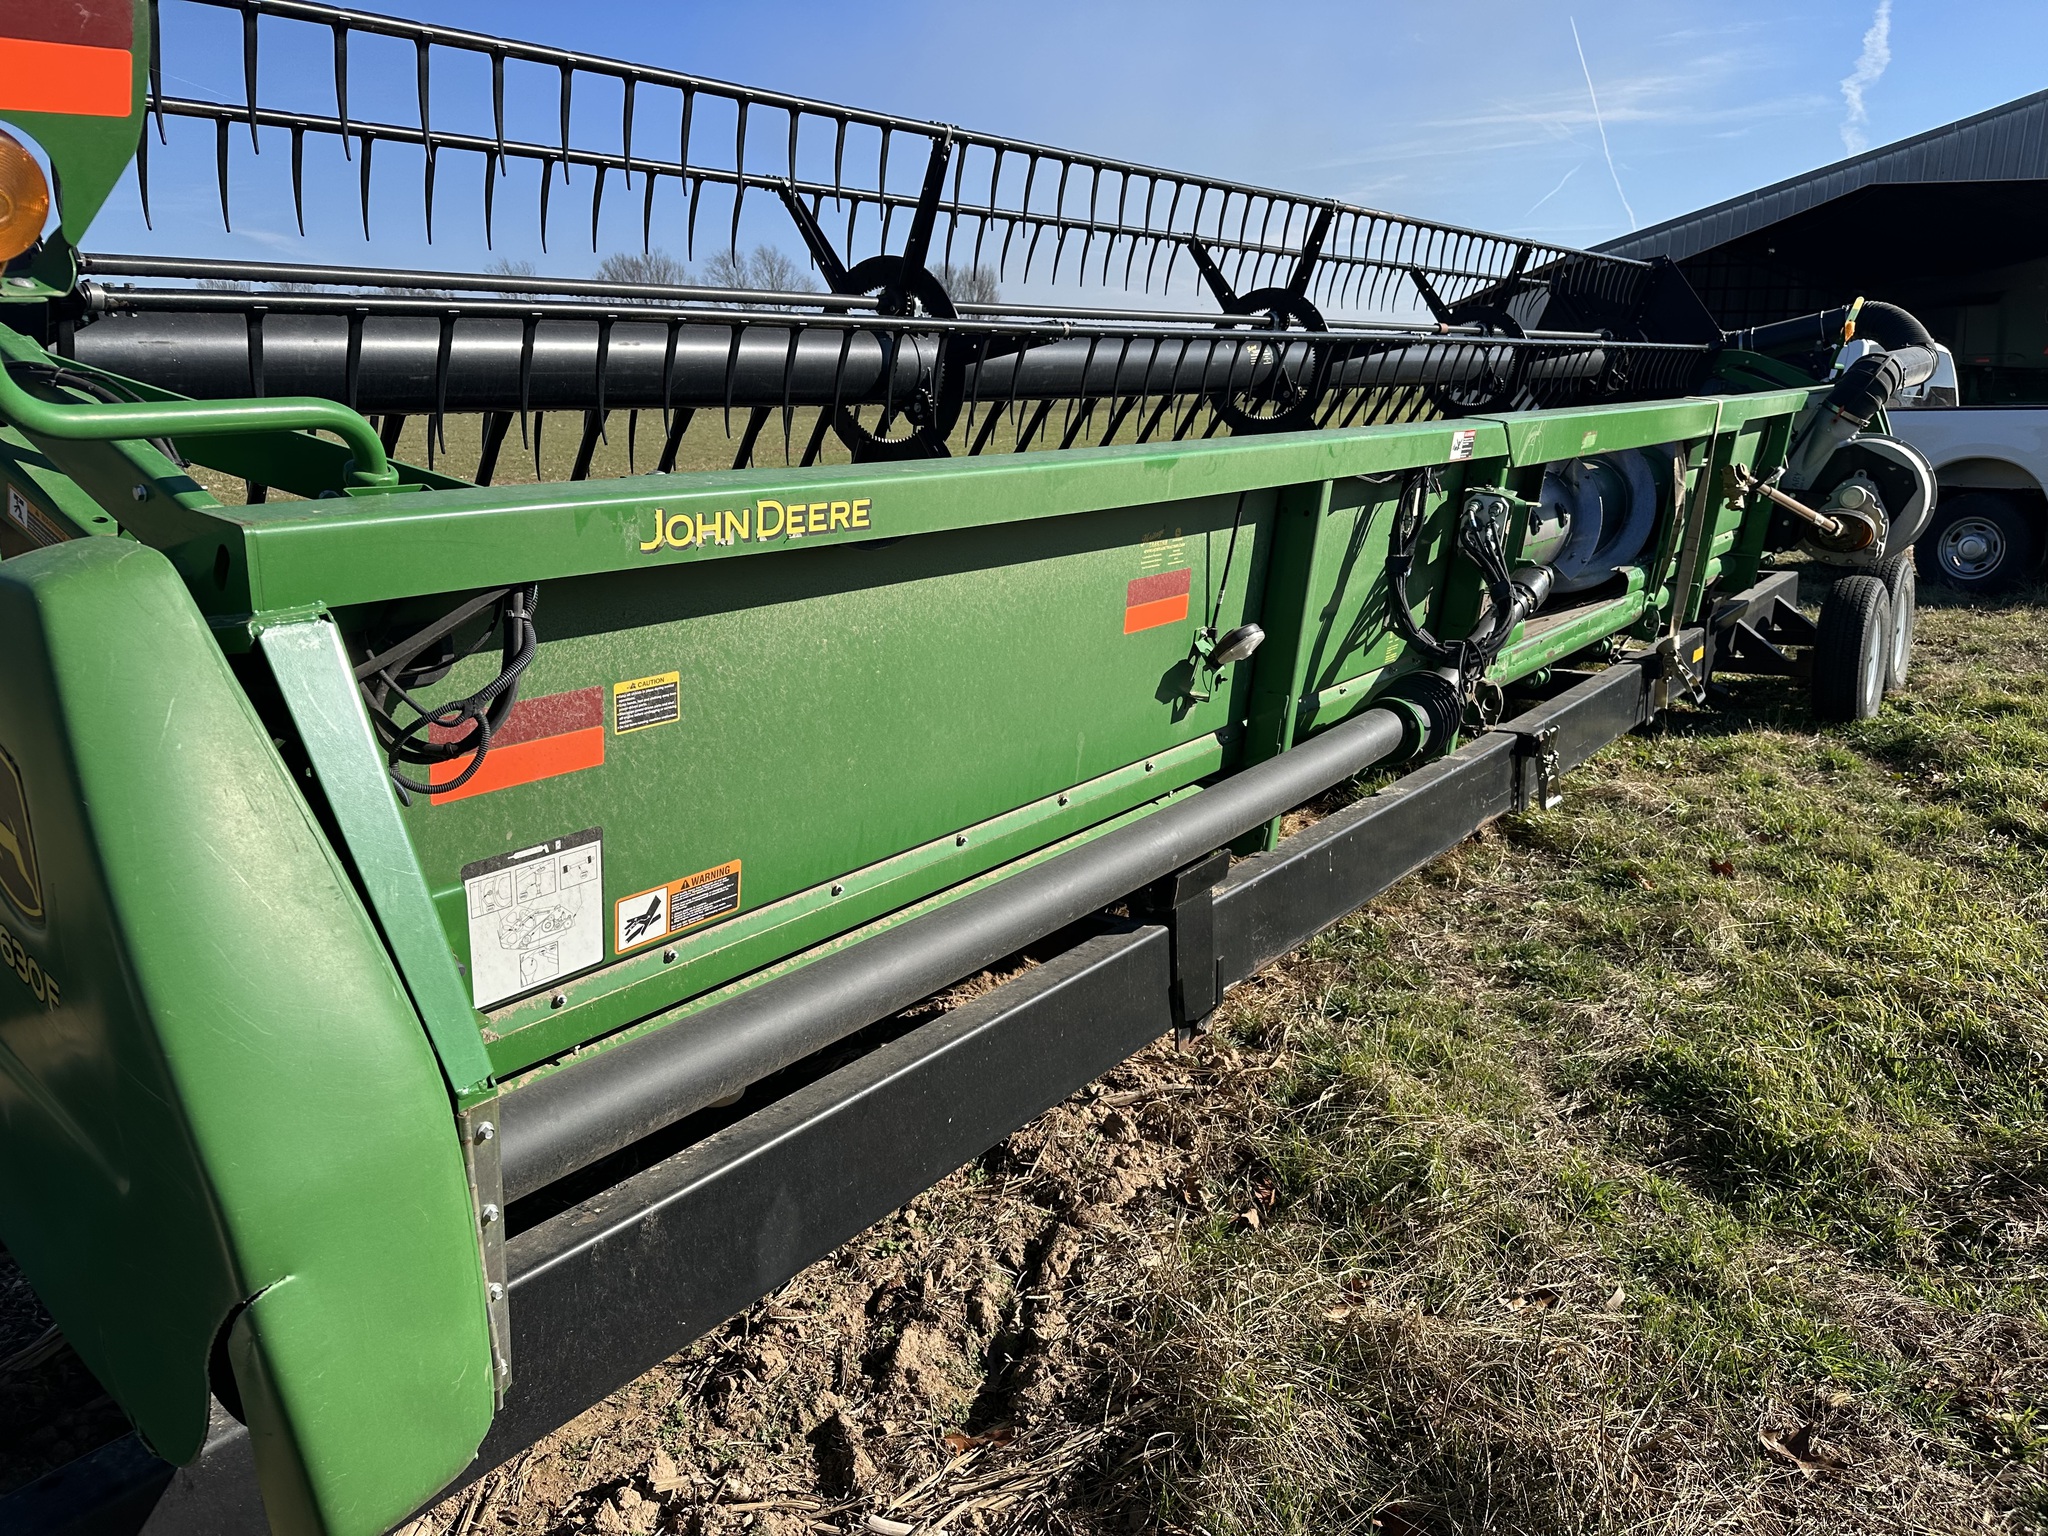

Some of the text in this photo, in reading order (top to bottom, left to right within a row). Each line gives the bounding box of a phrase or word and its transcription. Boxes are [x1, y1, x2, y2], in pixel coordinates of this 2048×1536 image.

[640, 498, 871, 554] JOHN DEERE
[637, 677, 665, 688] CAUTION
[691, 865, 731, 887] WARNING
[0, 924, 60, 1013] 630F
